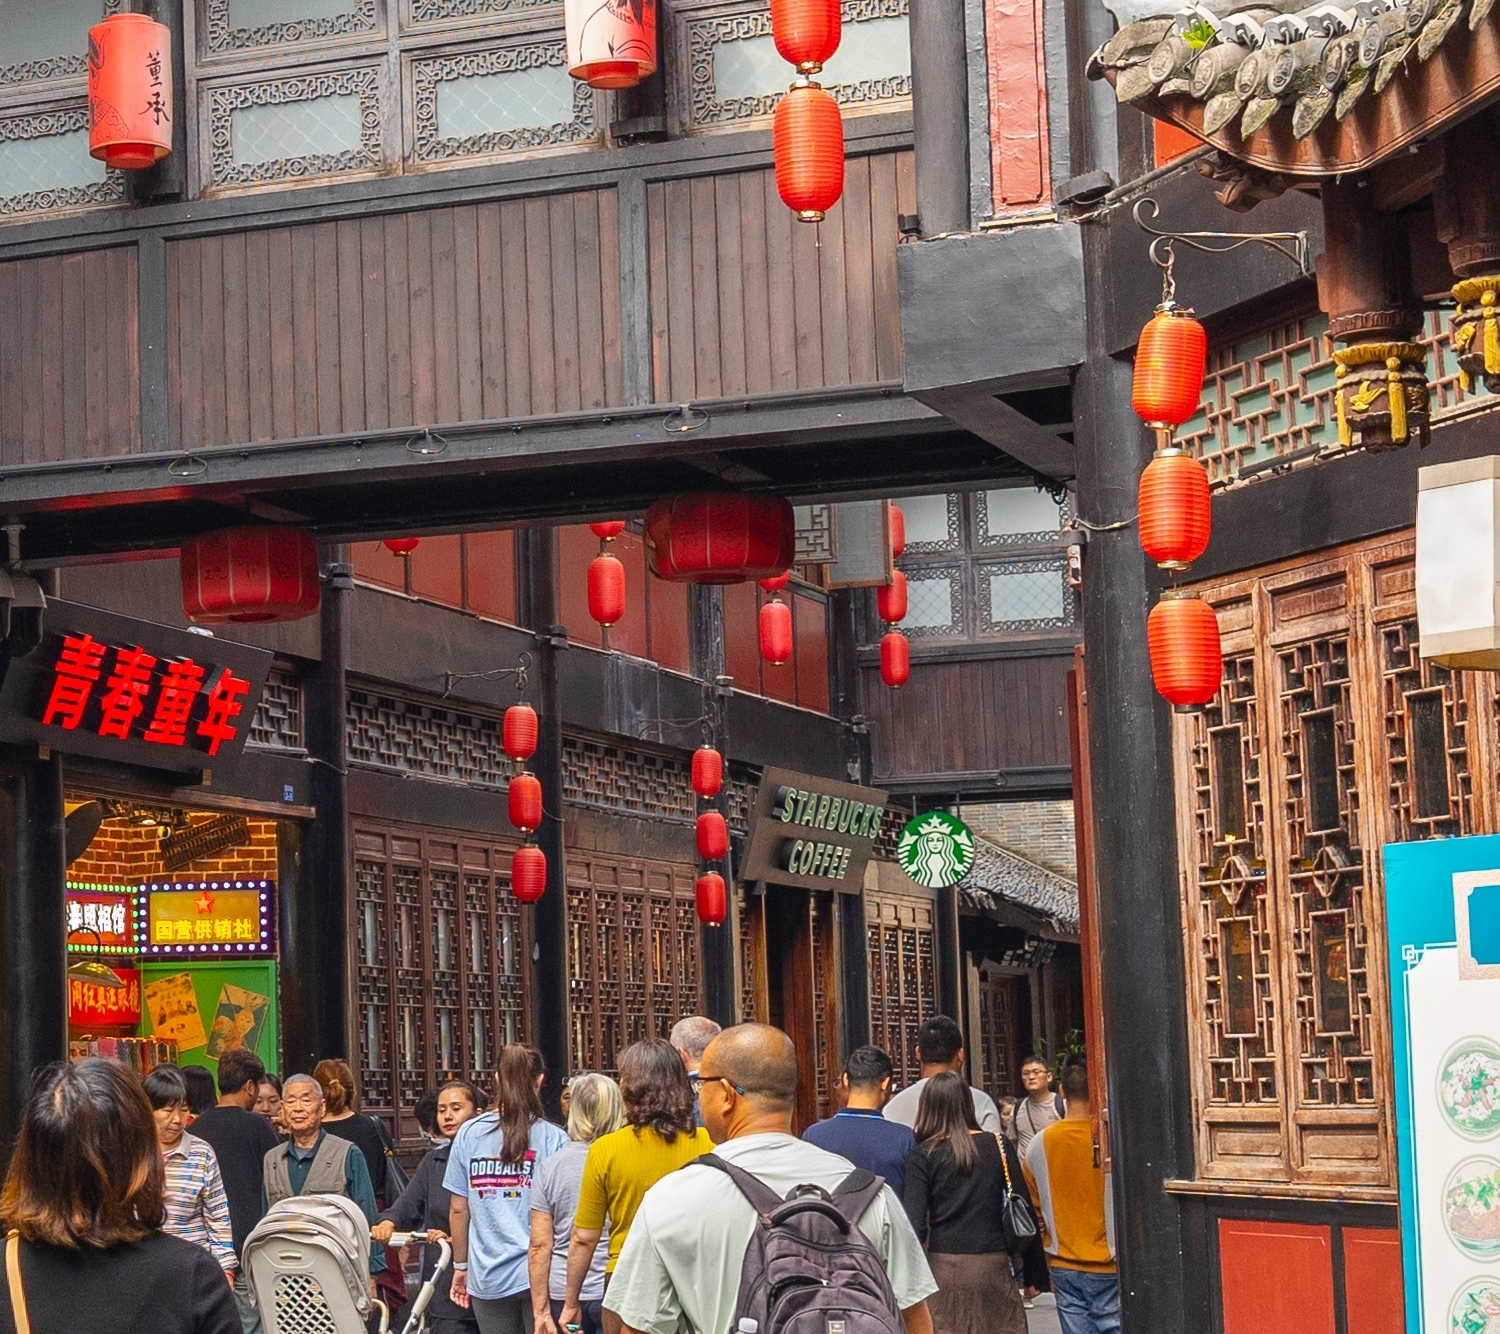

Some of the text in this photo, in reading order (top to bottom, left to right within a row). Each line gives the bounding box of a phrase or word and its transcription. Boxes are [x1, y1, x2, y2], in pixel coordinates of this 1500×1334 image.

[138, 50, 170, 127] 董承
[42, 633, 250, 756] 青春童年
[781, 788, 885, 839] STARBUCKS
[789, 840, 851, 879] COFFEE
[155, 919, 253, 940] 国营供销社
[471, 1161, 531, 1176] ODDBALLS
